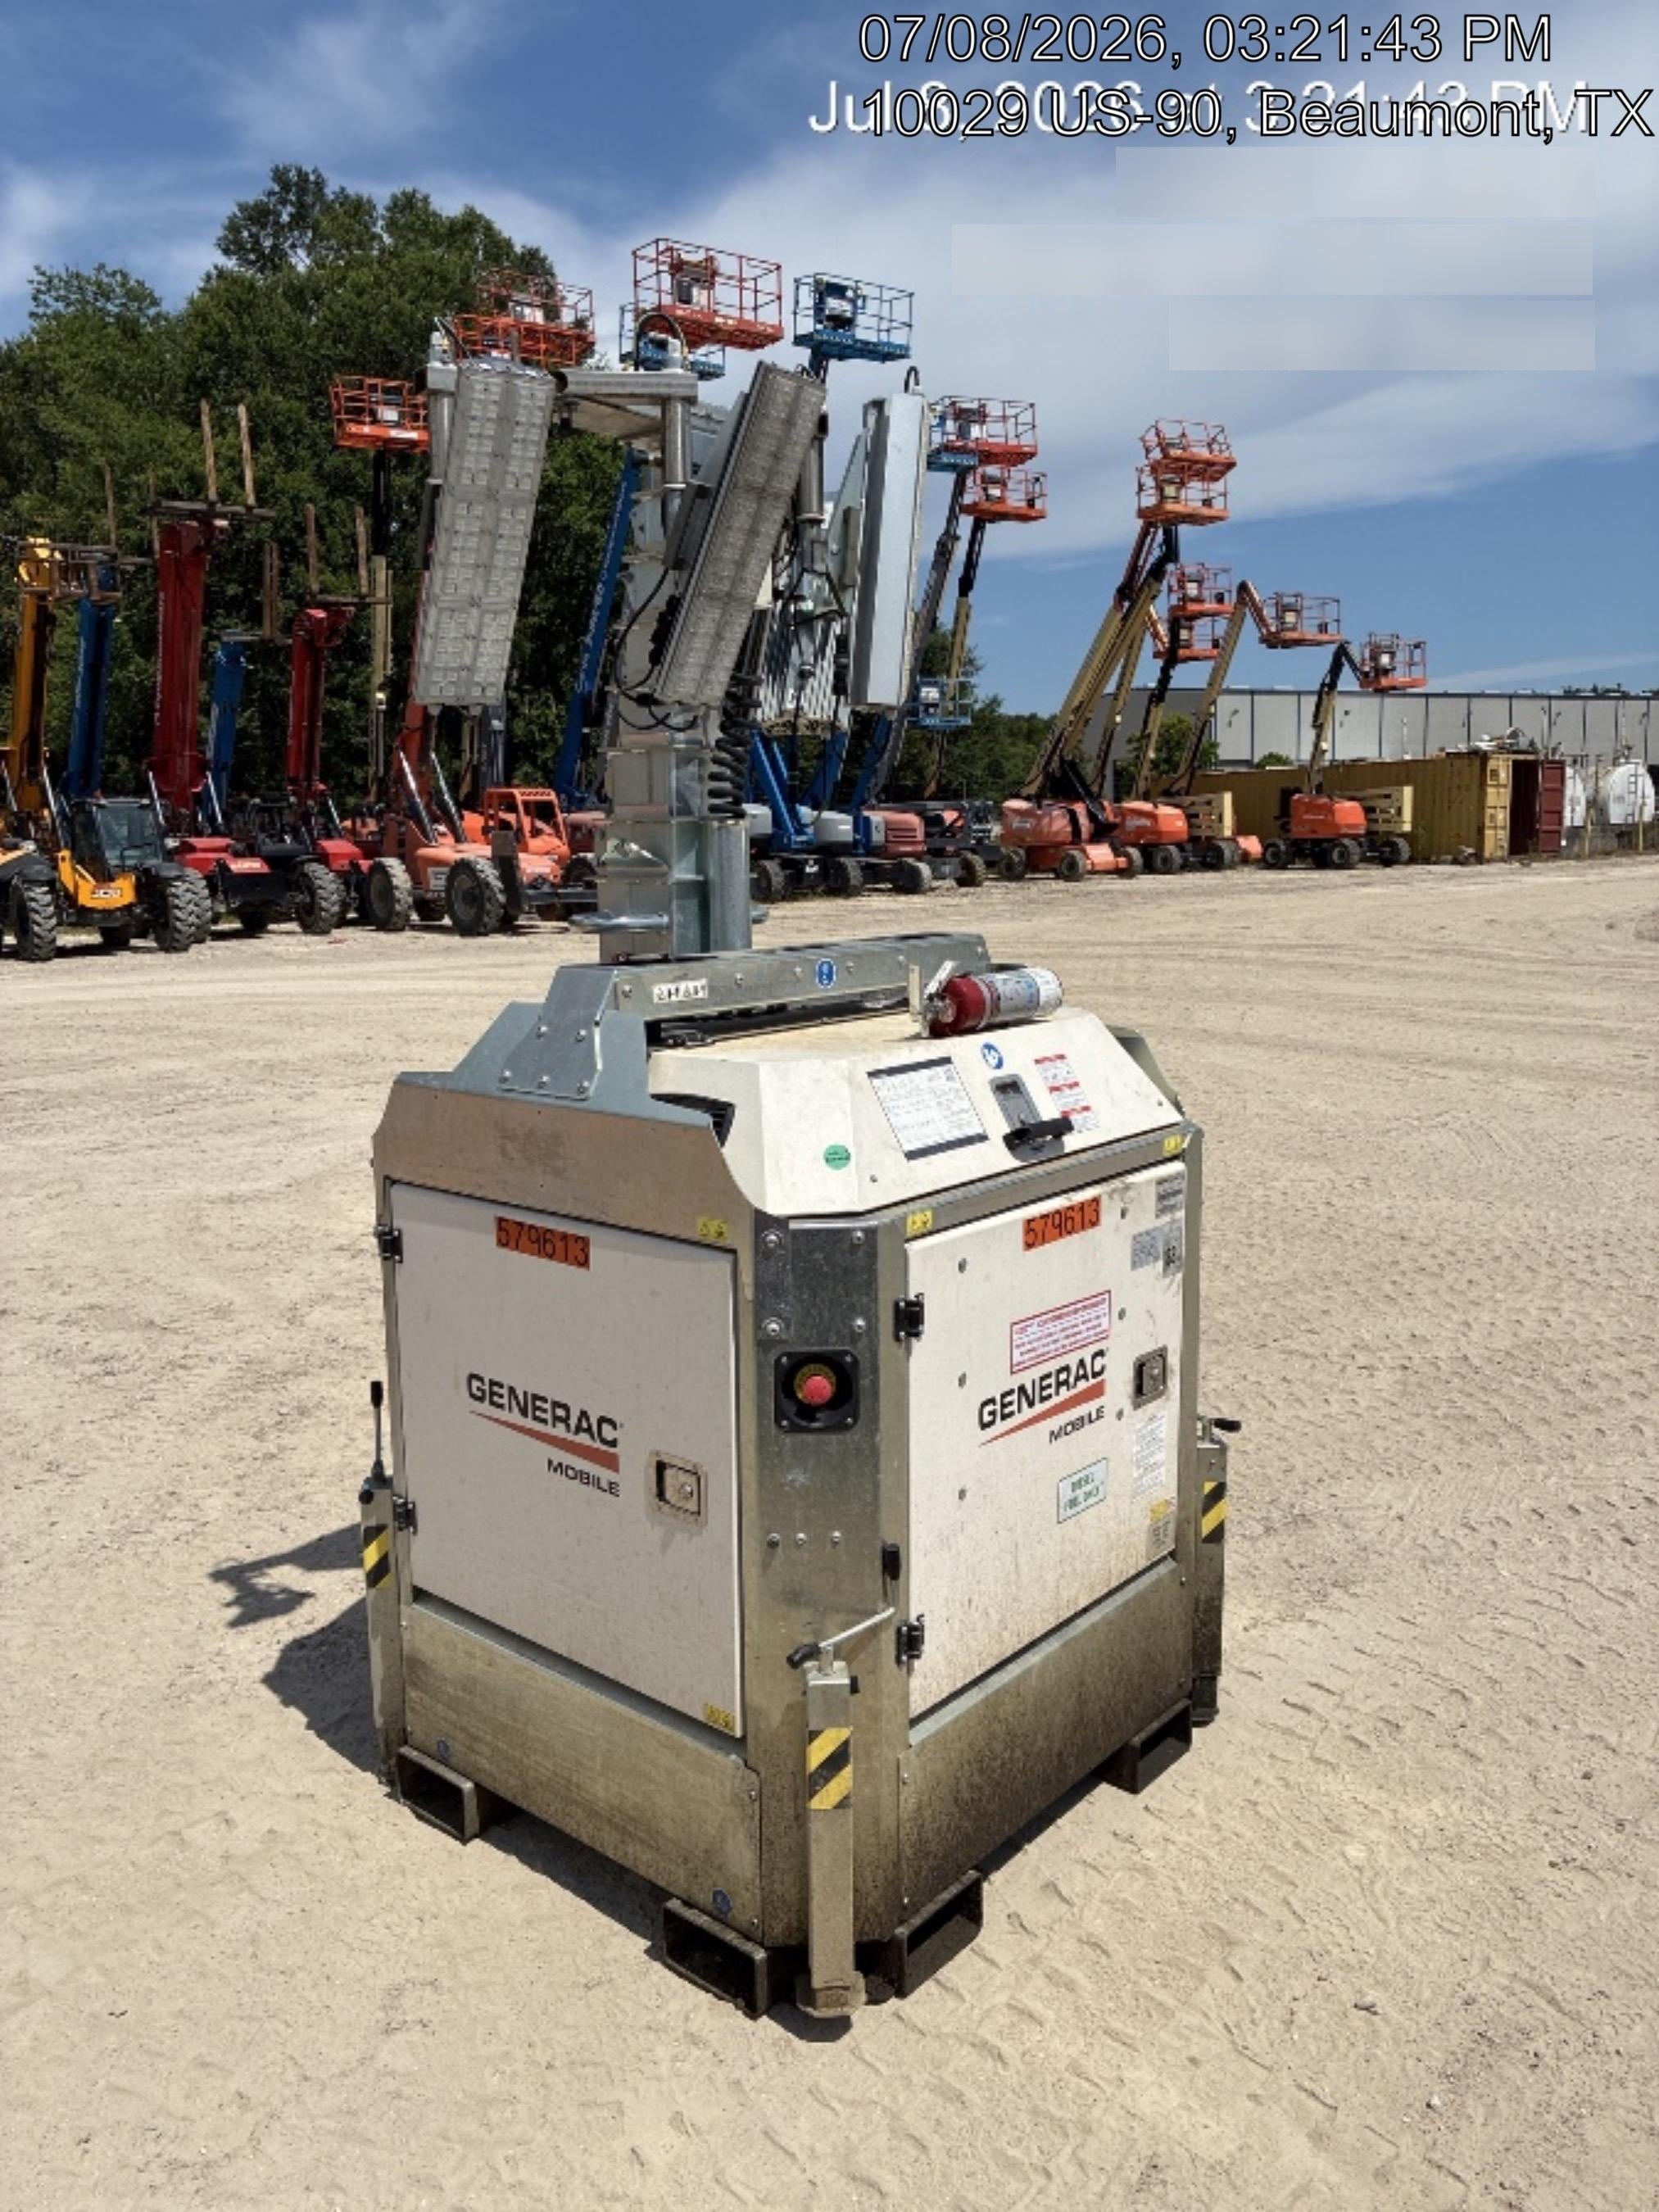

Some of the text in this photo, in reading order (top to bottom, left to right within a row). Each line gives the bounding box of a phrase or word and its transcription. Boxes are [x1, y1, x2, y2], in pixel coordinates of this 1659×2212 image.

[496, 1217, 588, 1267] 579613
[1025, 1197, 1099, 1249] 579613
[467, 1372, 619, 1448] GENERAC
[978, 1349, 1106, 1431] GENERAC
[1049, 1405, 1104, 1444] MOBILE
[547, 1457, 620, 1498] MOBILE
